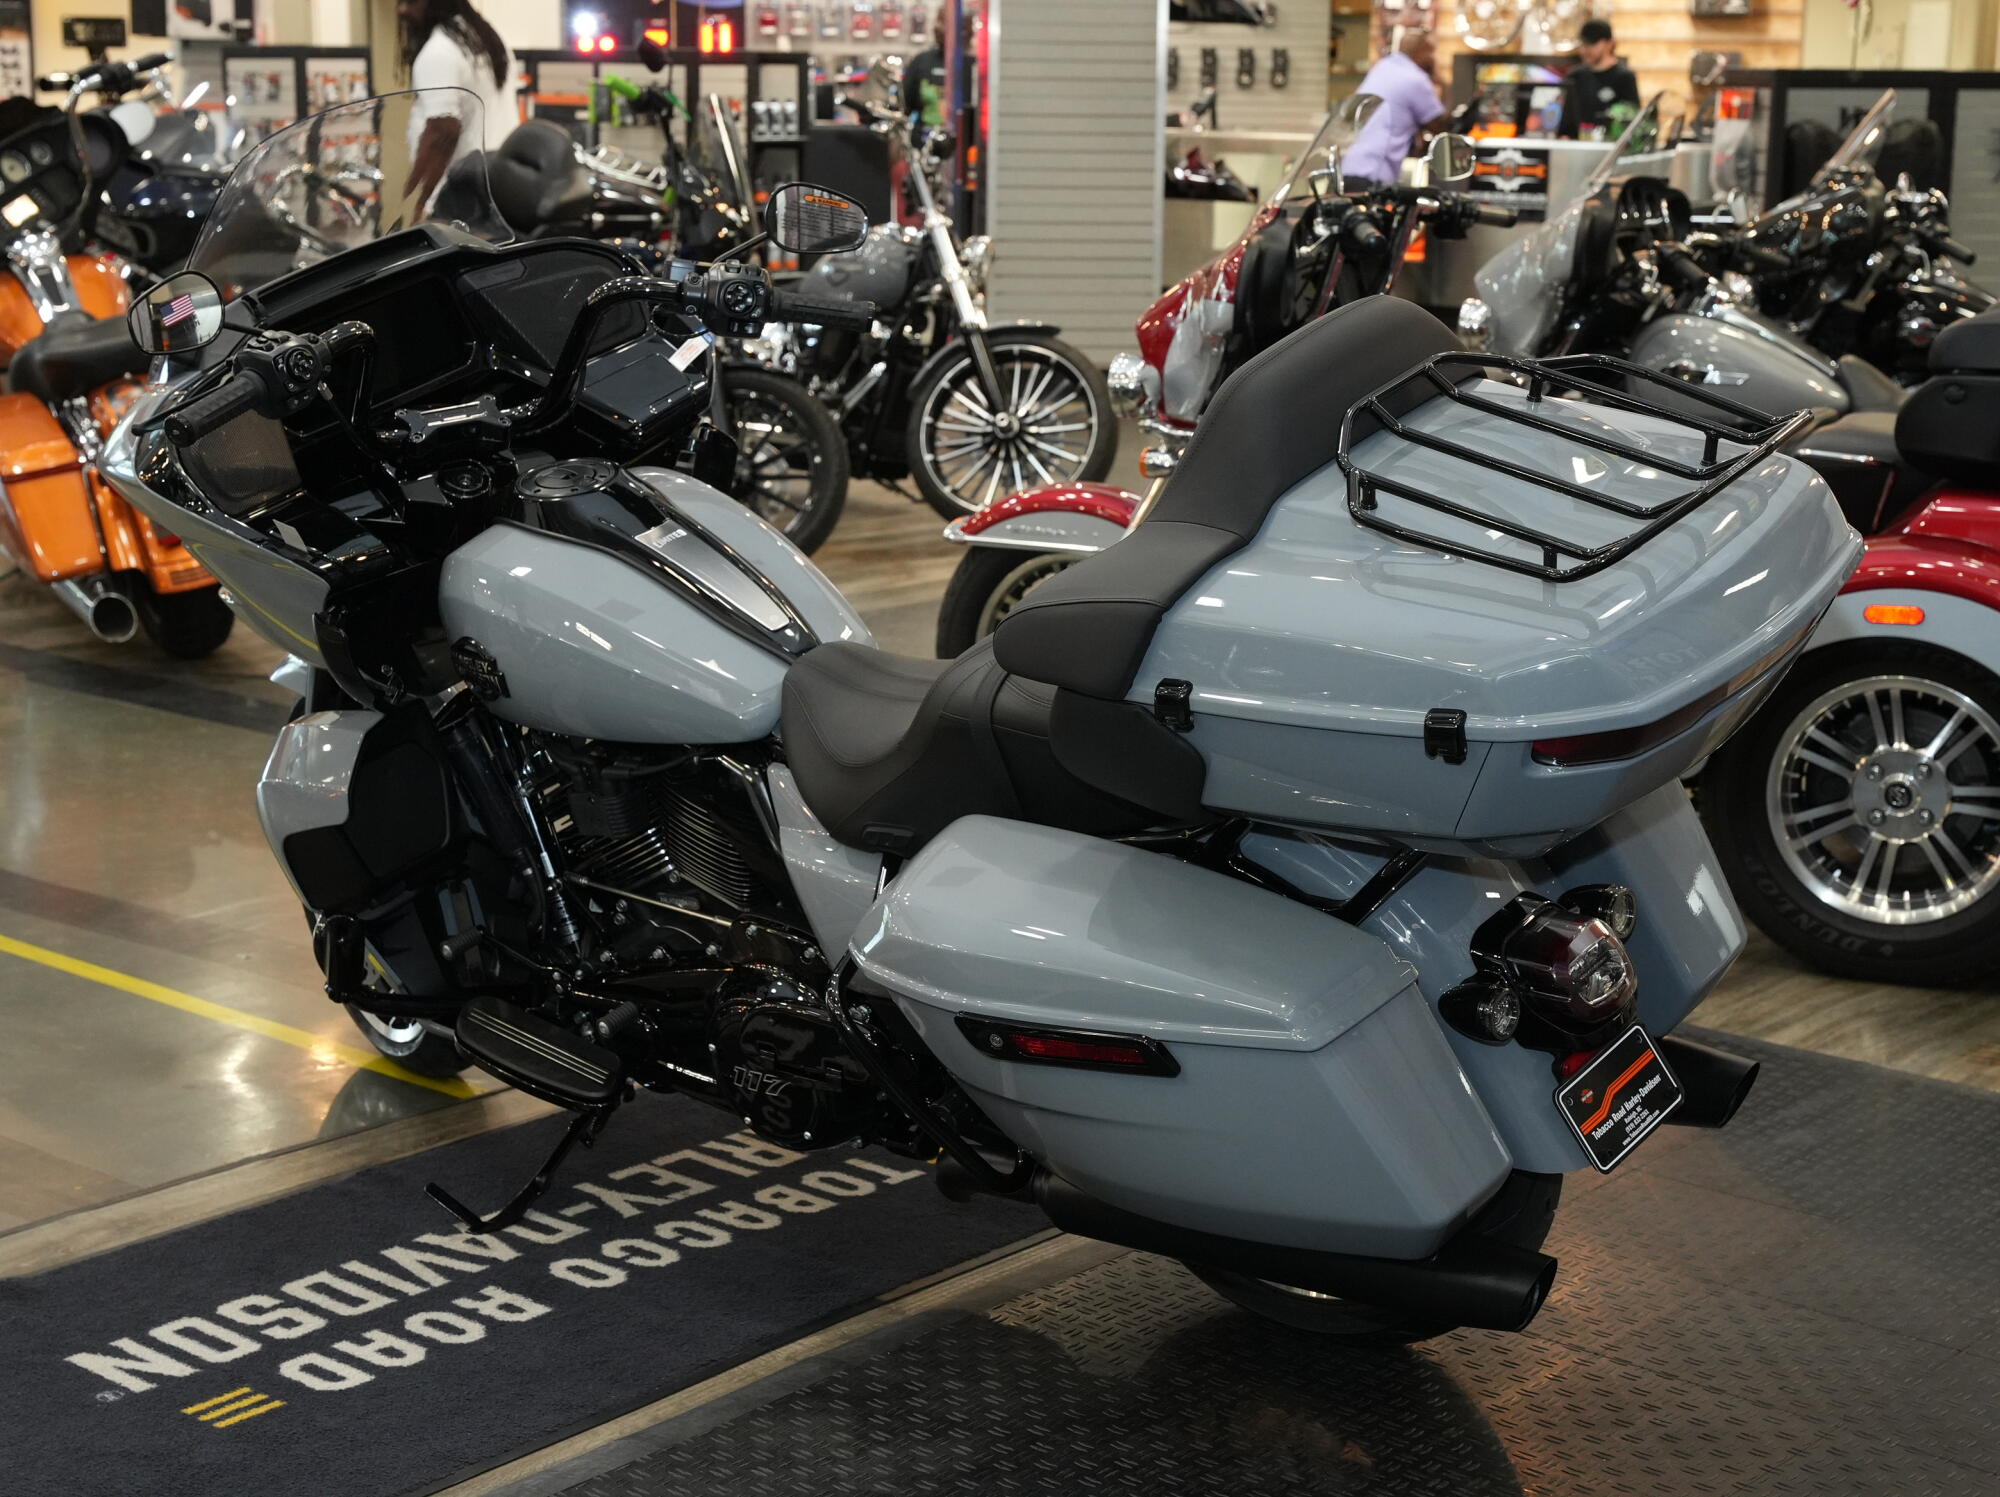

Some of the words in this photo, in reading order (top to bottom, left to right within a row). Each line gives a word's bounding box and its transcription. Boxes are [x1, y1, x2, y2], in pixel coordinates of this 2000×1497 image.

[652, 528, 688, 548] LIMITED
[732, 1065, 793, 1097] 117
[1591, 1119, 1614, 1140] Tobacco
[1611, 1105, 1627, 1122] Road
[1624, 1074, 1661, 1111] Harley-Davidson
[64, 1129, 808, 1393] RLEY-DAVIDSON
[548, 1158, 926, 1289] TOBACCO
[279, 1285, 553, 1391] ROAD
